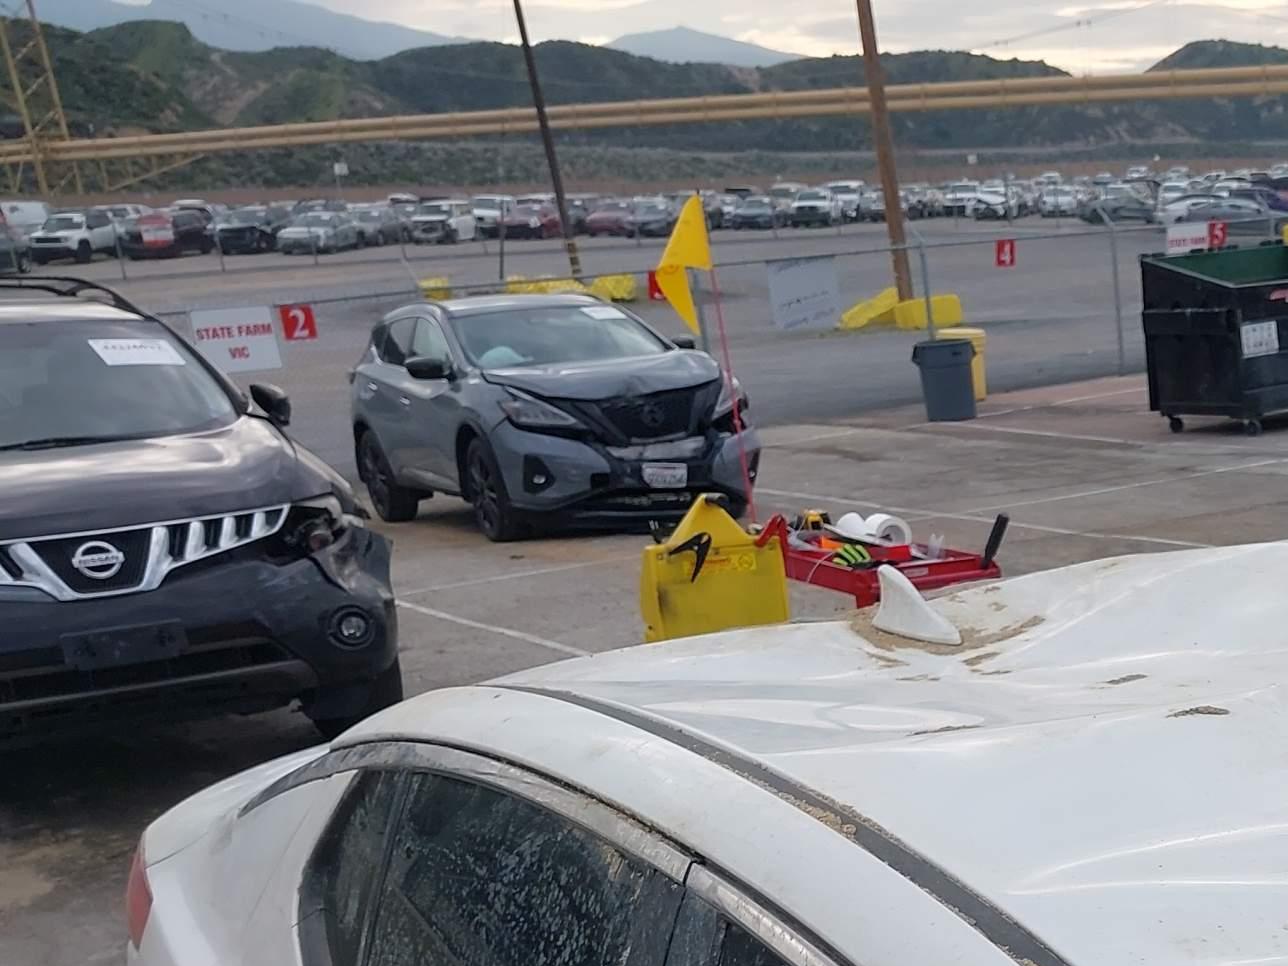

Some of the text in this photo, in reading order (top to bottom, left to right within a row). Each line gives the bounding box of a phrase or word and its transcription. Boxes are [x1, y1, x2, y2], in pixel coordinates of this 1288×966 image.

[1213, 222, 1225, 245] 5
[1000, 242, 1012, 266] 4
[195, 323, 274, 341] STATE FARM
[288, 308, 310, 338] 2
[228, 346, 250, 359] VIC
